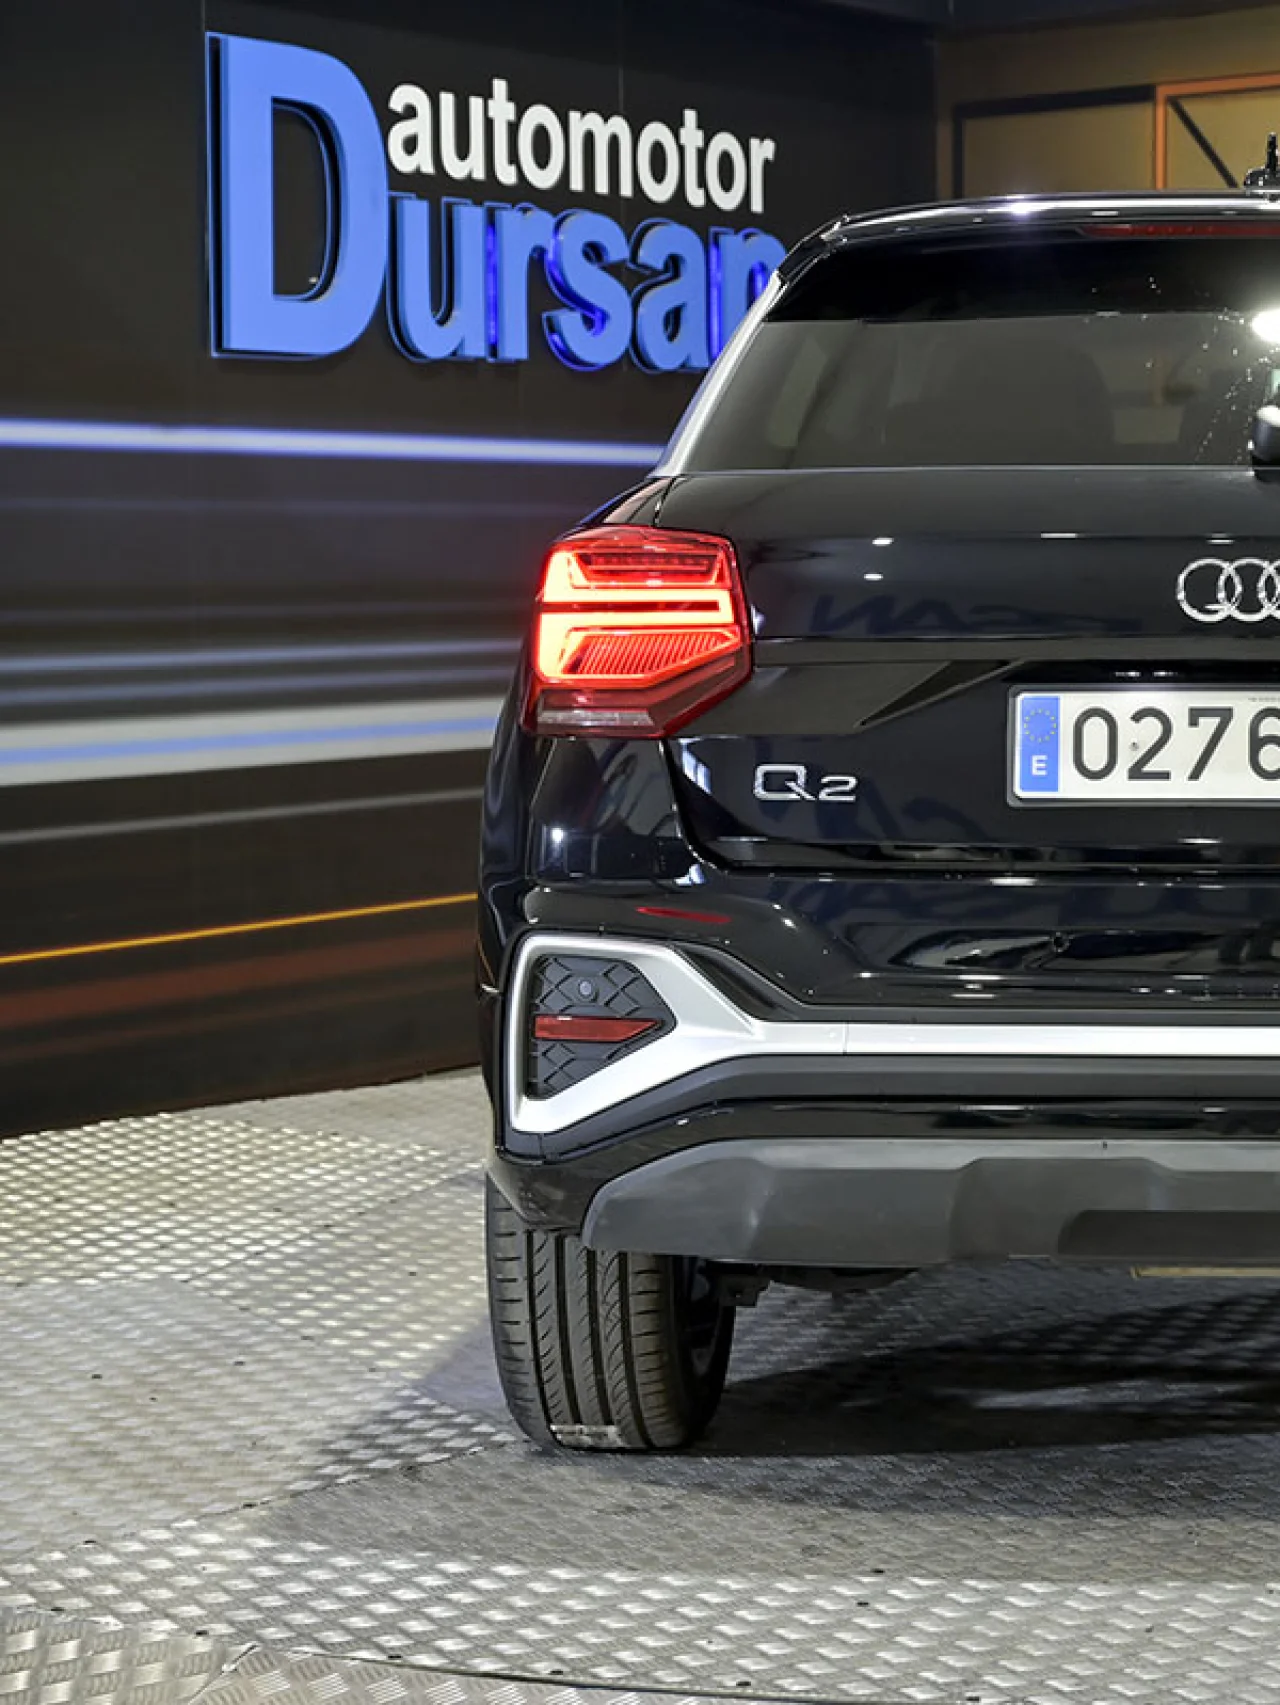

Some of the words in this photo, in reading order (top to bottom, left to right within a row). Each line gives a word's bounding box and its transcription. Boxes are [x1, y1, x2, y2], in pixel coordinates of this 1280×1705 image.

[387, 78, 775, 214] automotor
[205, 31, 788, 373] Dursan
[753, 763, 858, 802] Q2
[1031, 755, 1048, 776] E
